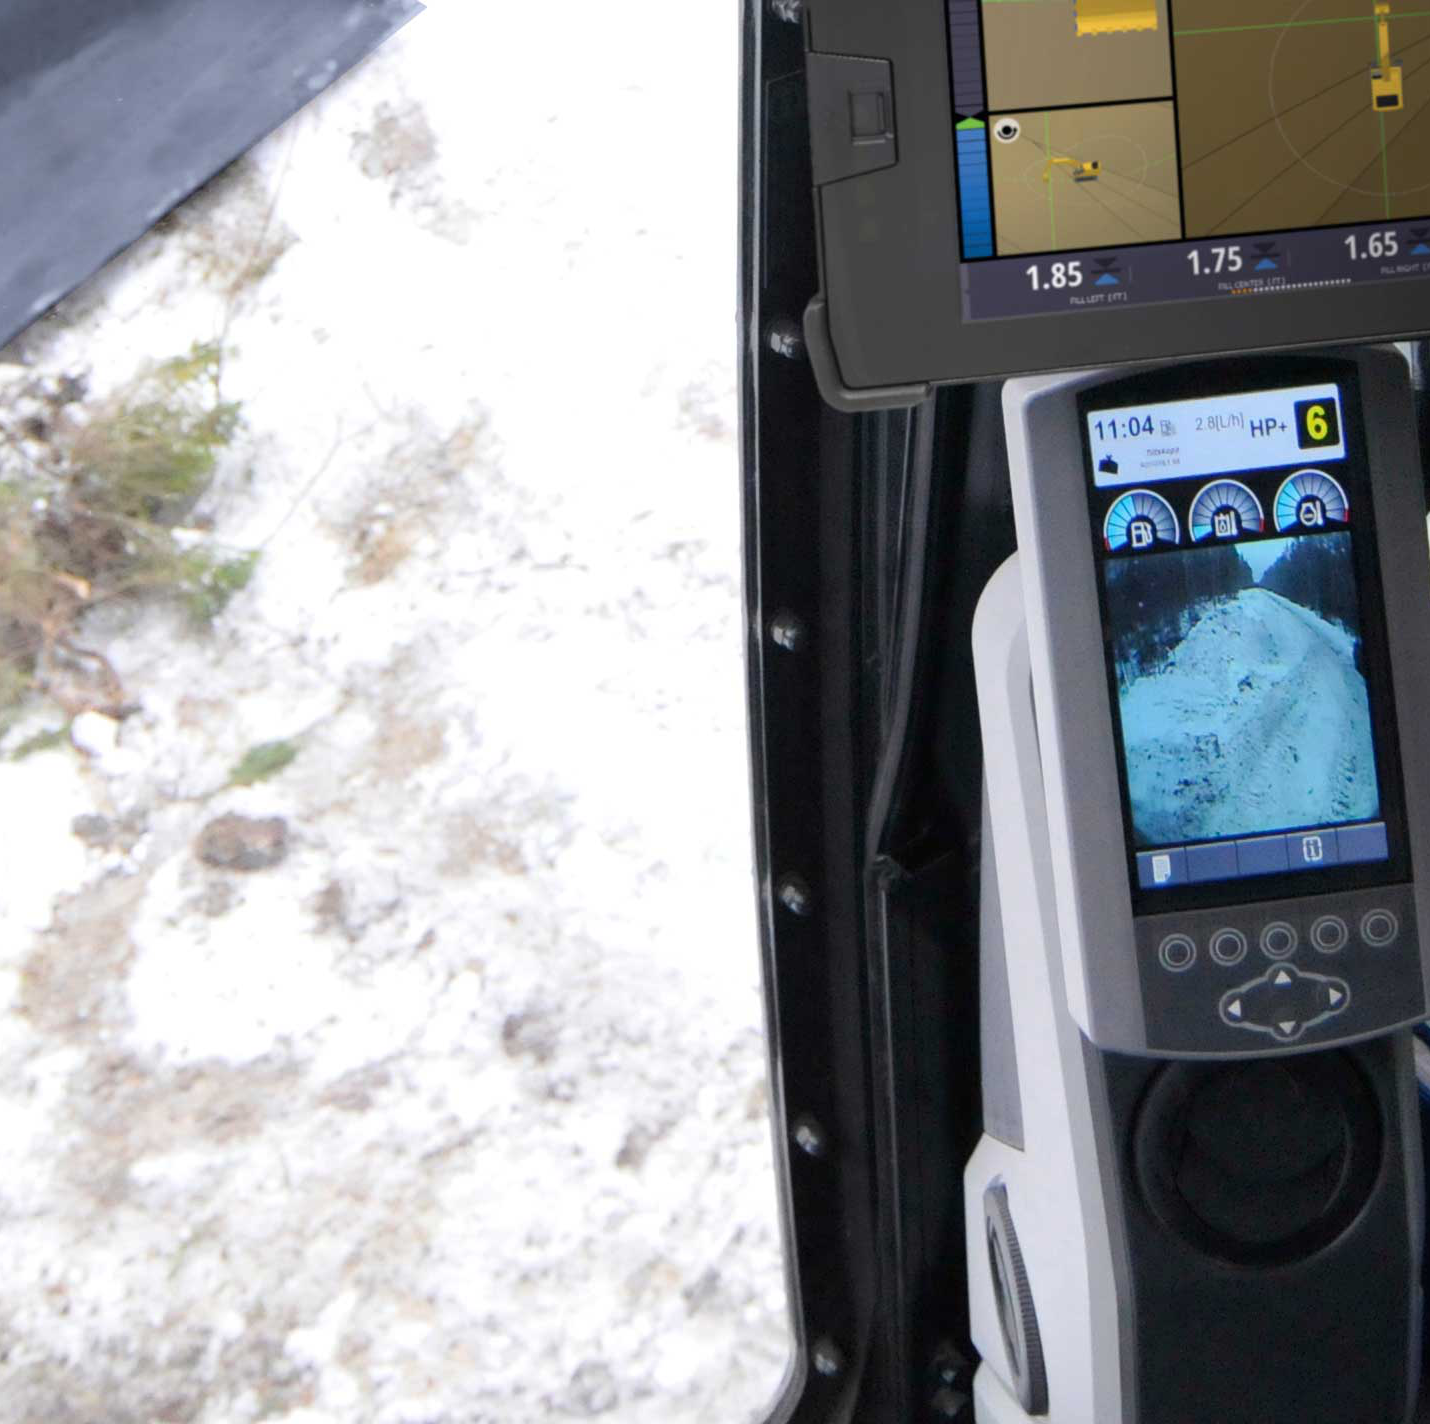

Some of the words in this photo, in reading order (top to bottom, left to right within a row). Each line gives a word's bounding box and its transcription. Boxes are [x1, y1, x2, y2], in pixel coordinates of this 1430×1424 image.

[1187, 245, 1243, 275] 1.75
[1344, 230, 1399, 260] 1.65
[1026, 260, 1083, 291] 1.85
[1094, 414, 1154, 440] 11:04
[1306, 405, 1328, 441] 6
